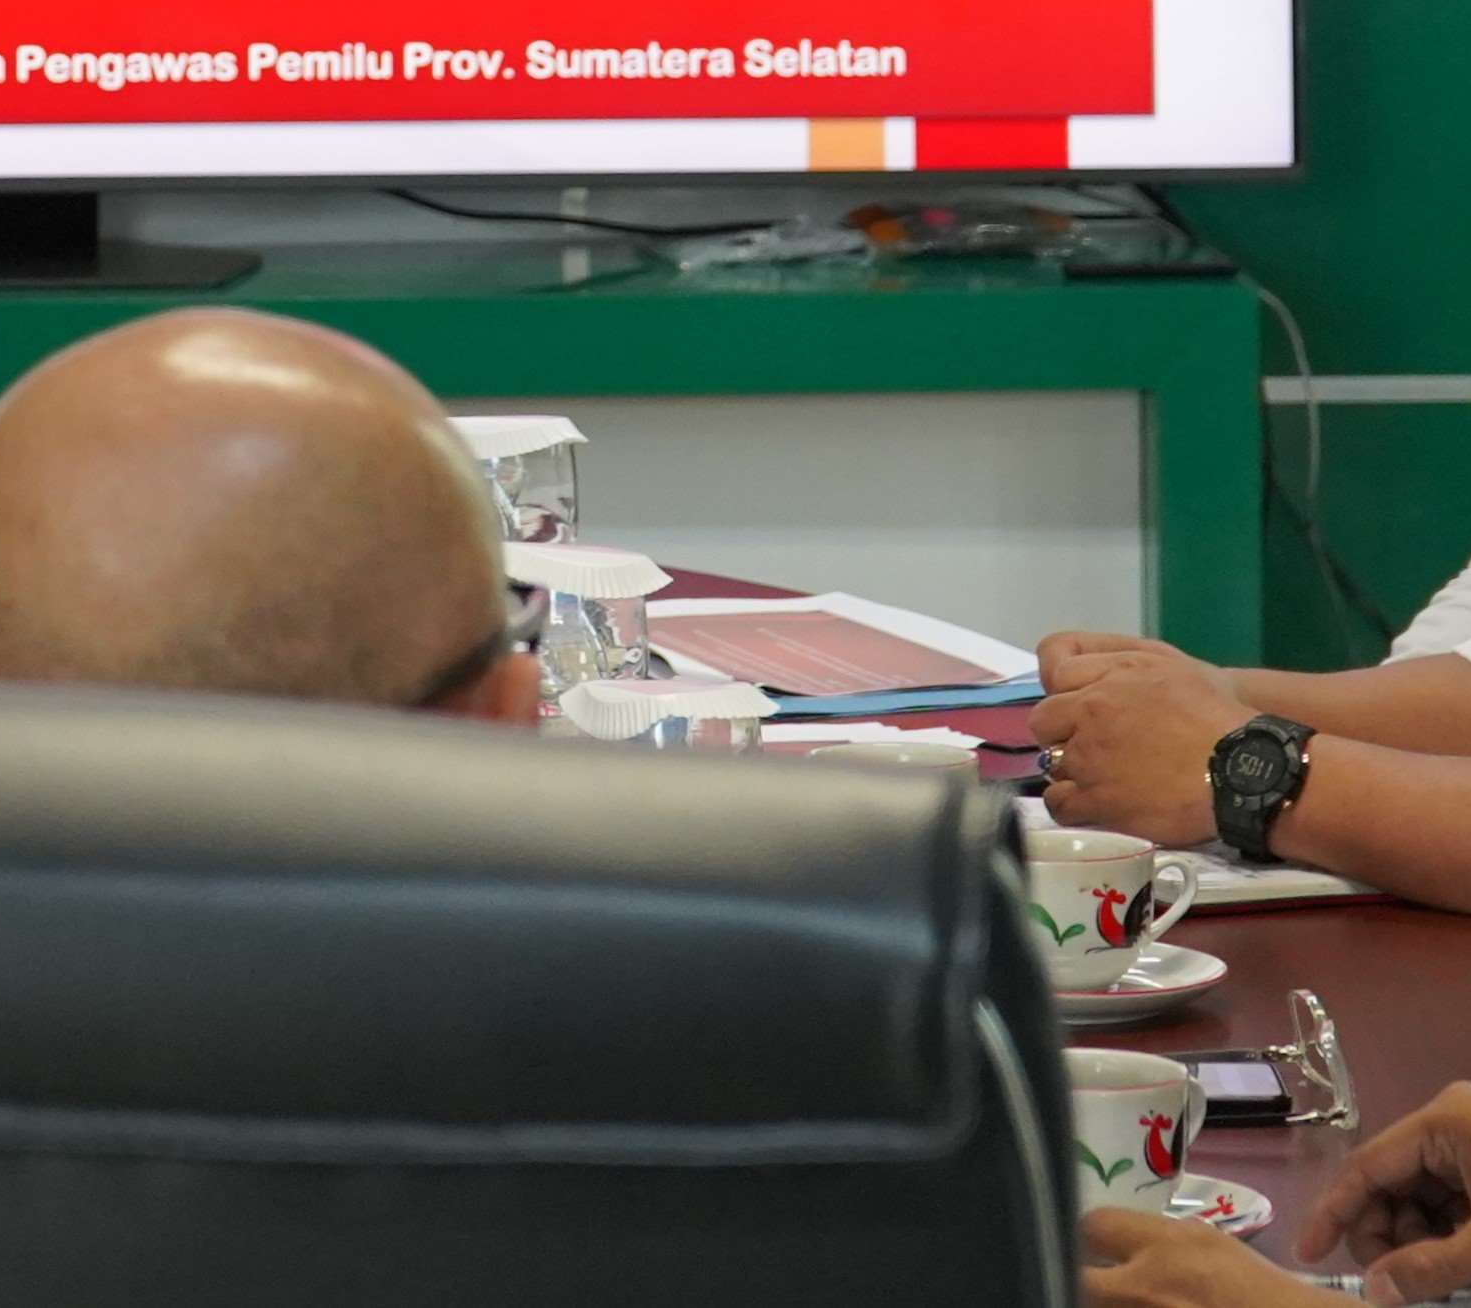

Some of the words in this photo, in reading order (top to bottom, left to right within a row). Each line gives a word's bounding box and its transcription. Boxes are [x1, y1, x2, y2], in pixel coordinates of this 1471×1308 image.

[16, 45, 238, 90] Pengawas
[248, 43, 393, 81] Pemilu
[404, 42, 514, 80] Prov.
[526, 40, 734, 79] Sumatera
[744, 39, 906, 77] Selatan
